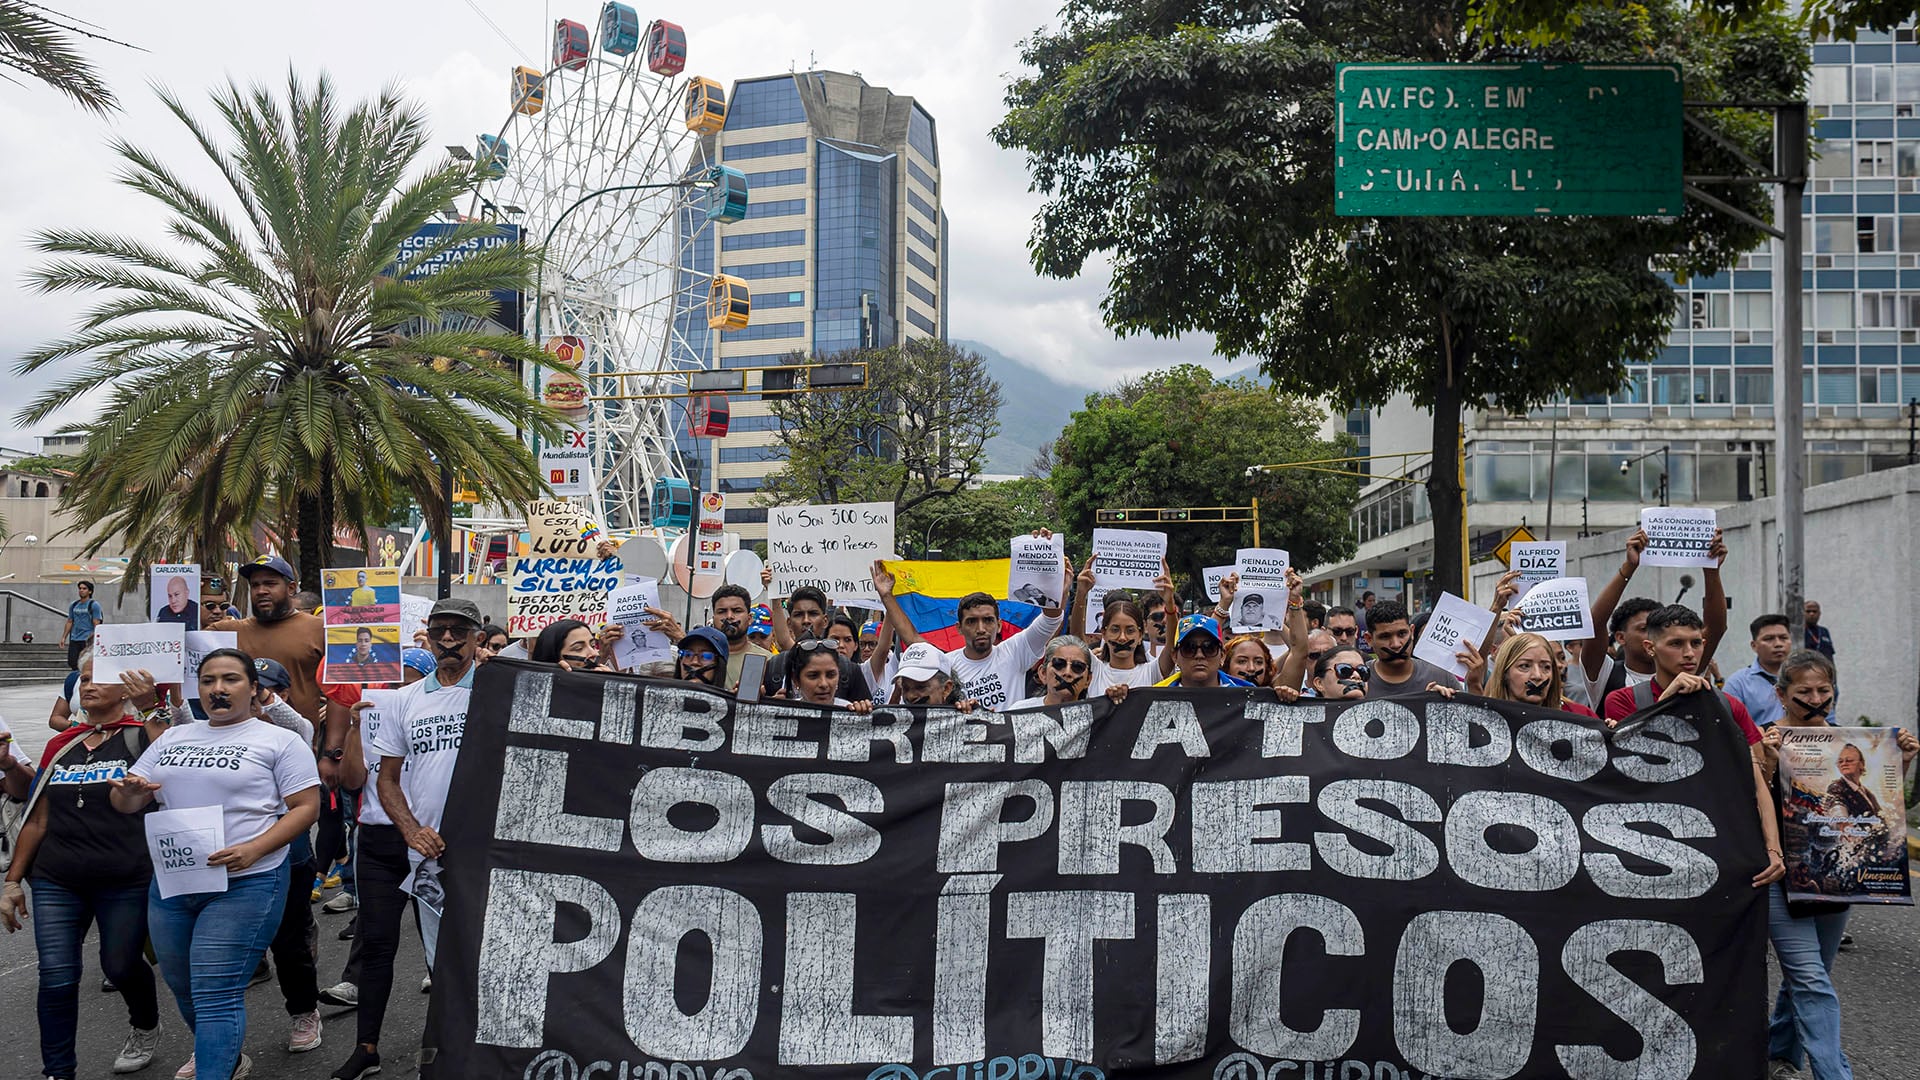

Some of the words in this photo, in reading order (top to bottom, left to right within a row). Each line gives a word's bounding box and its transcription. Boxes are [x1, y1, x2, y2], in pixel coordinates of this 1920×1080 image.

[1357, 87, 1396, 109] AV.
[542, 451, 589, 460] Mundialistas
[831, 508, 858, 525] 300
[1664, 518, 1715, 526] CONDICIONES
[553, 528, 573, 537] DE
[533, 536, 588, 554] LUTO
[700, 540, 722, 552] ESP
[818, 538, 839, 554] 700
[1097, 539, 1132, 548] NINGUNA
[1134, 541, 1161, 549] MADRE
[1649, 540, 1711, 549] MATANDO
[513, 557, 592, 579] MARCHA
[1119, 560, 1159, 569] CUSTODIA
[1241, 558, 1285, 566] REINALDO
[1519, 556, 1557, 568] DÍAZ
[155, 566, 178, 574] CARLOS
[178, 566, 194, 574] VIDAL
[1095, 567, 1115, 576] DEL
[1119, 569, 1159, 578] ESTADO
[1245, 566, 1281, 574] ARAUJO
[513, 577, 618, 593] SILENCIO
[509, 594, 574, 607] LIBERTAD
[578, 591, 609, 603] PARA
[617, 593, 648, 604] RAFAEL
[1530, 589, 1578, 600] CRUELDAD
[1541, 596, 1579, 606] VÍCTIMAS
[519, 604, 571, 615] TODOS
[579, 602, 605, 613] LOS
[616, 602, 650, 613] ACOSTA
[1564, 603, 1580, 611] LAS
[1439, 615, 1452, 626] NI
[1522, 614, 1581, 630] CÁRCEL
[1435, 623, 1459, 638] UNO
[1430, 631, 1455, 647] MÁS
[967, 681, 1002, 699] PRESOS
[411, 714, 446, 729] LIBEREN
[449, 714, 455, 722] A
[508, 671, 1093, 763] LIBEREN
[1130, 700, 1211, 759] A
[1244, 699, 1704, 783] TODOS
[412, 726, 432, 741] LOS
[437, 722, 465, 736] PRES
[1781, 729, 1835, 746] Carmen
[413, 735, 462, 756] POLÍTIC
[52, 767, 126, 783] CUENTA
[493, 745, 885, 865] LOS
[936, 774, 1719, 900] PRESOS
[160, 837, 174, 848] NI
[162, 847, 193, 859] UNO
[165, 855, 196, 870] MÁS
[1856, 867, 1904, 884] Venezuela
[475, 867, 1704, 1080] POLÍTICOS
